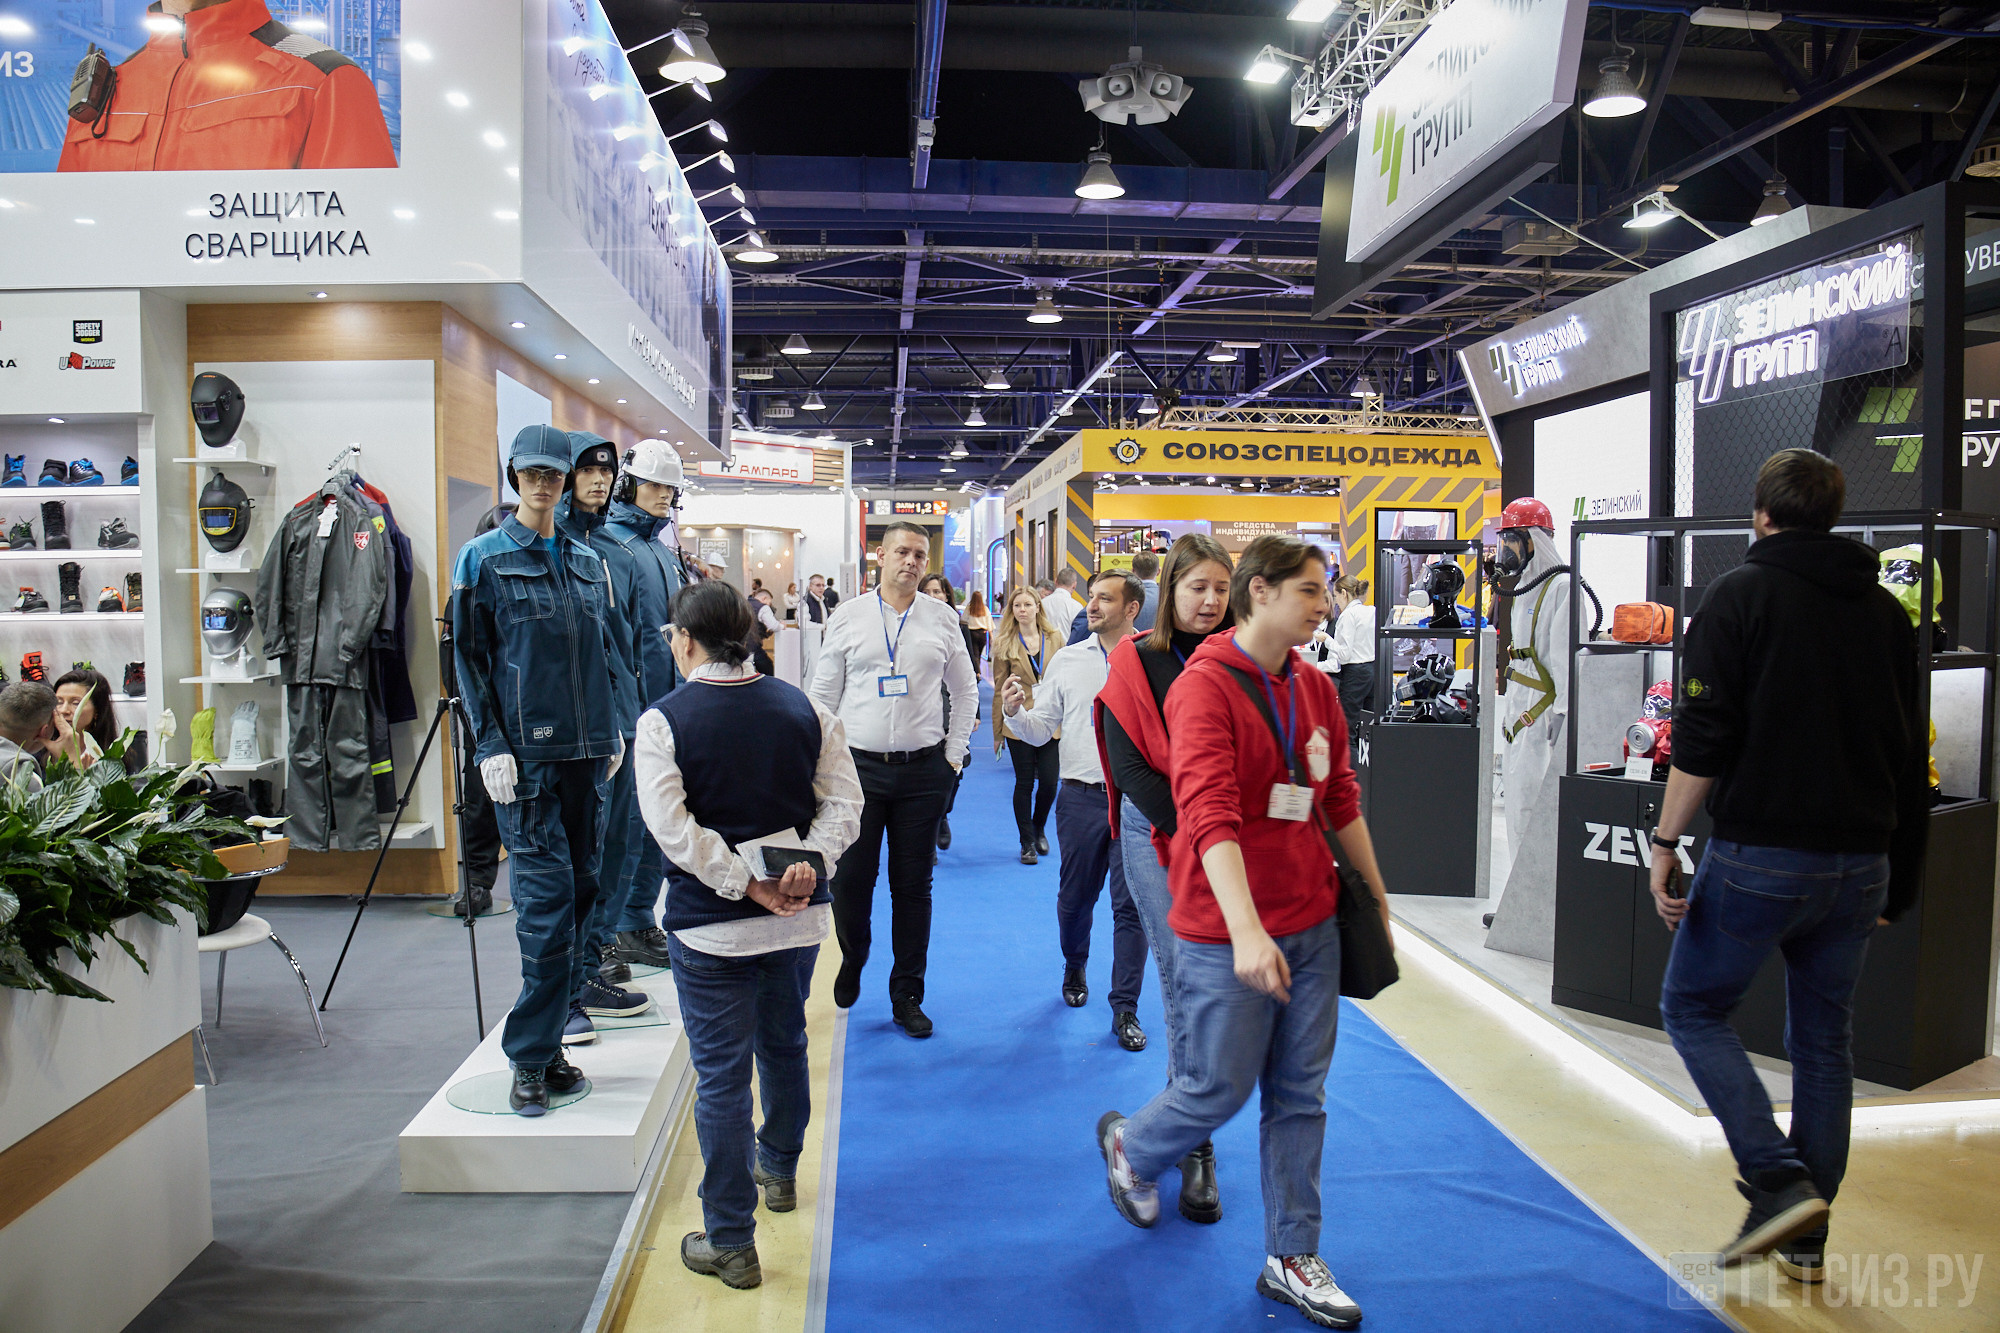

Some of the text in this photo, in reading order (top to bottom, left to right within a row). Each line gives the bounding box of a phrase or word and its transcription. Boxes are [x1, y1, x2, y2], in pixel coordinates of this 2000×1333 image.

[1411, 82, 1473, 175] ГРУПП
[208, 191, 346, 223] ЗАЩИТА
[185, 230, 370, 262] СВАРЩИКА
[1735, 243, 1908, 345] ЗЕЛИНСКИЙ
[75, 322, 101, 330] SAFETY
[75, 329, 101, 337] JOGGER
[1512, 315, 1586, 365] ЗЕЛИНСКИЙ
[1520, 357, 1563, 388] ГРУПП
[1733, 330, 1818, 390] ГРУПП
[1162, 442, 1482, 468] СОЮЗСПЕЦОДЕЖДА
[740, 464, 799, 479] АМПАРО
[915, 502, 932, 515] 1,2
[1591, 489, 1642, 516] ЗЕЛИНСКИЙ
